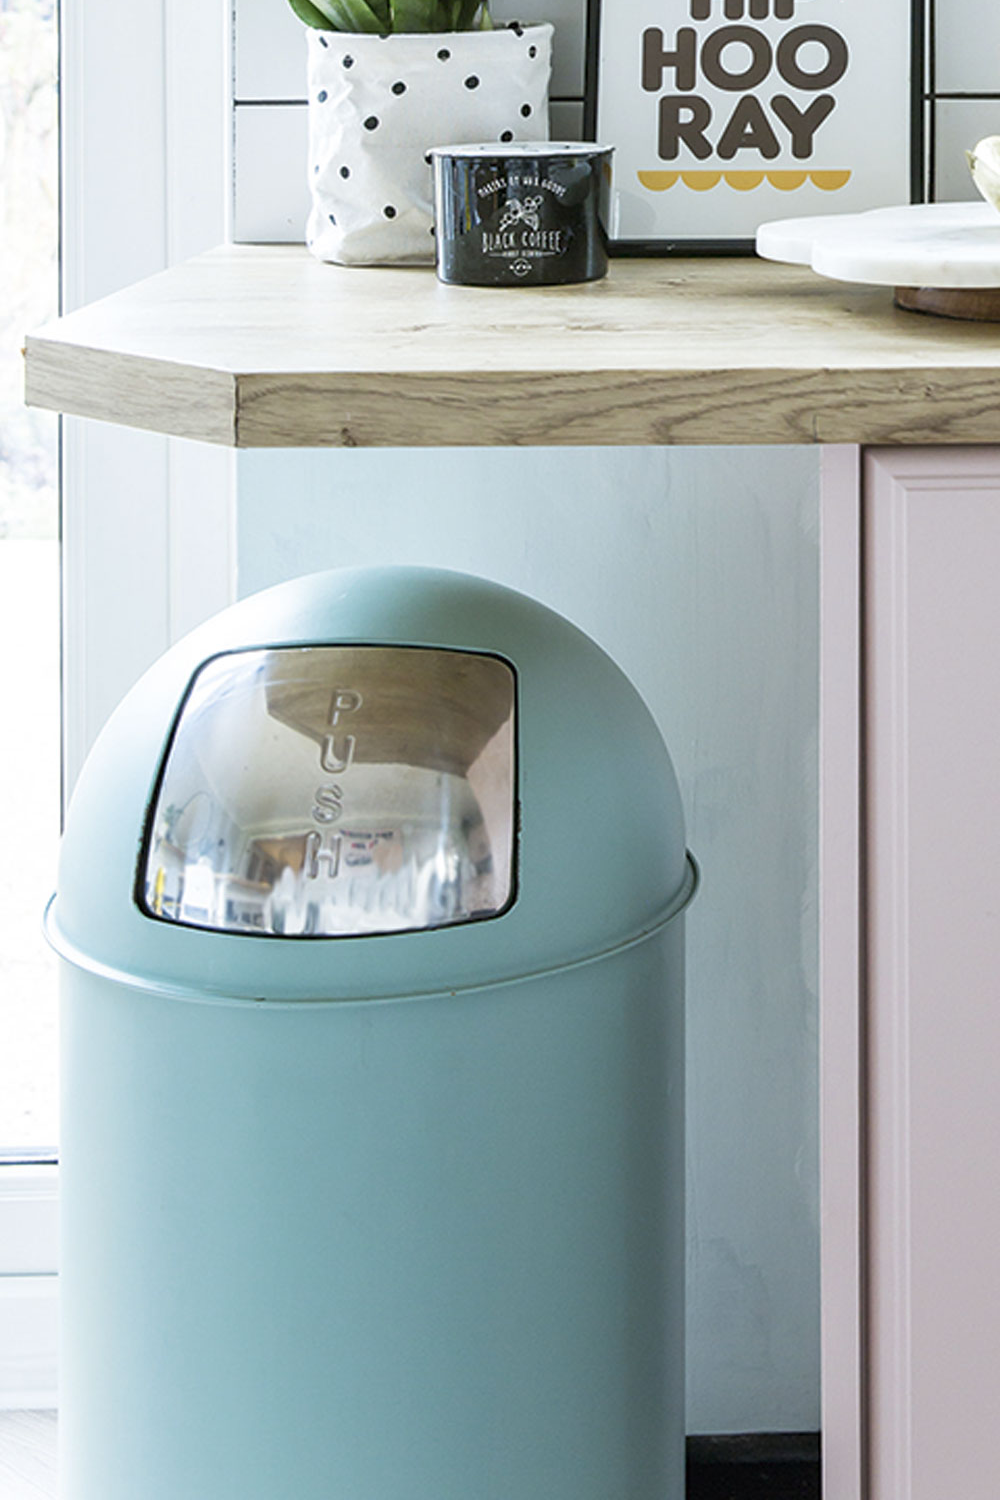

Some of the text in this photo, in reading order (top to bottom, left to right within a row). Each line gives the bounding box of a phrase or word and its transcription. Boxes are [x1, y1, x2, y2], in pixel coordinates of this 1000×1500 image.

[641, 24, 850, 92] HOO
[657, 94, 836, 161] RAY
[482, 230, 562, 254] BLACK COFFEE
[305, 688, 364, 879] PUSH
